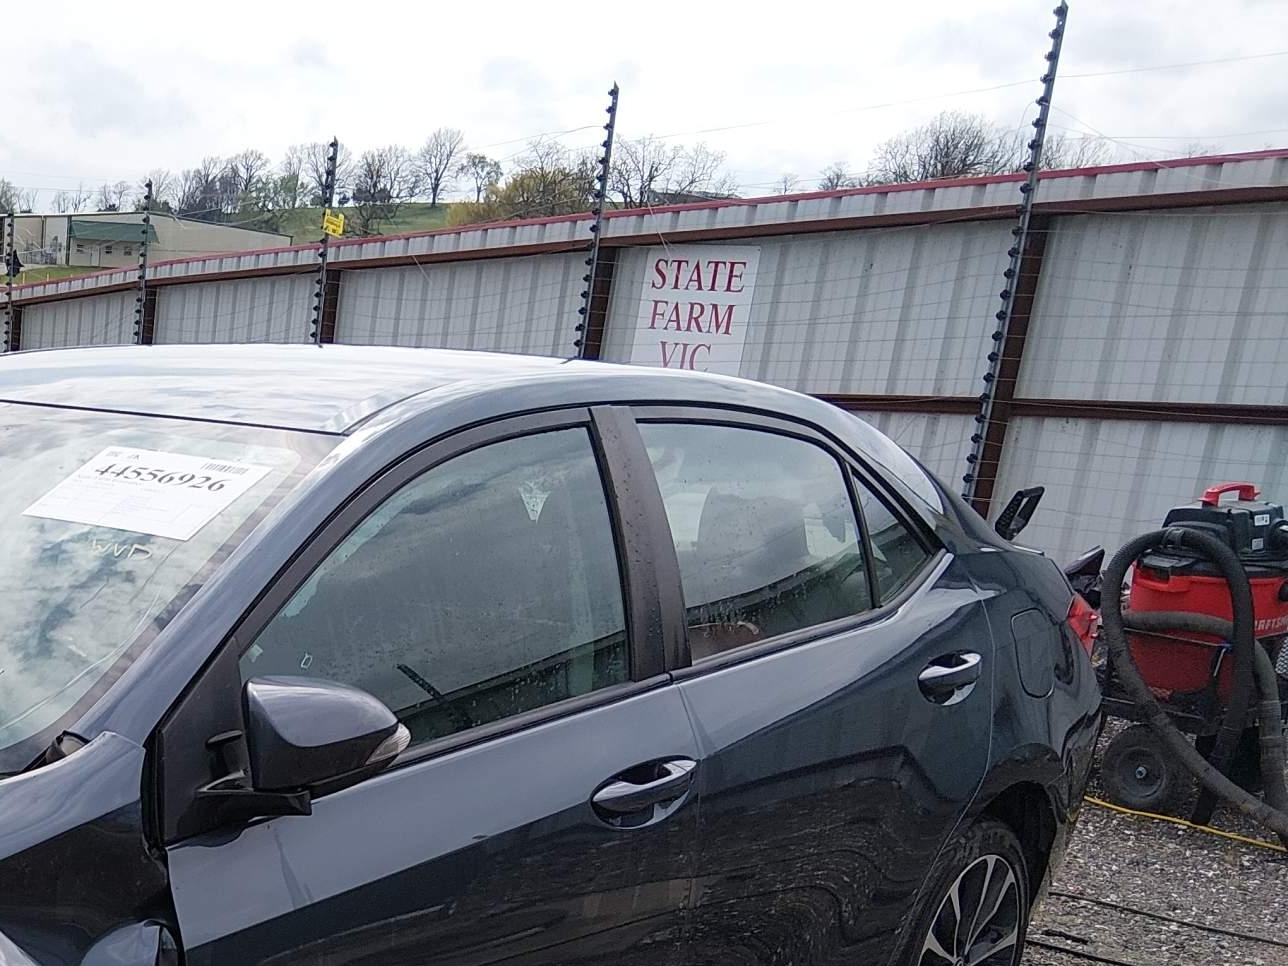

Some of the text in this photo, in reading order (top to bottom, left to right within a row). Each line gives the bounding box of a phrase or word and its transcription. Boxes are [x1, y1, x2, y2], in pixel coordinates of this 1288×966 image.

[651, 258, 748, 293] STATE
[648, 299, 737, 336] FARM
[94, 463, 229, 491] 44556926
